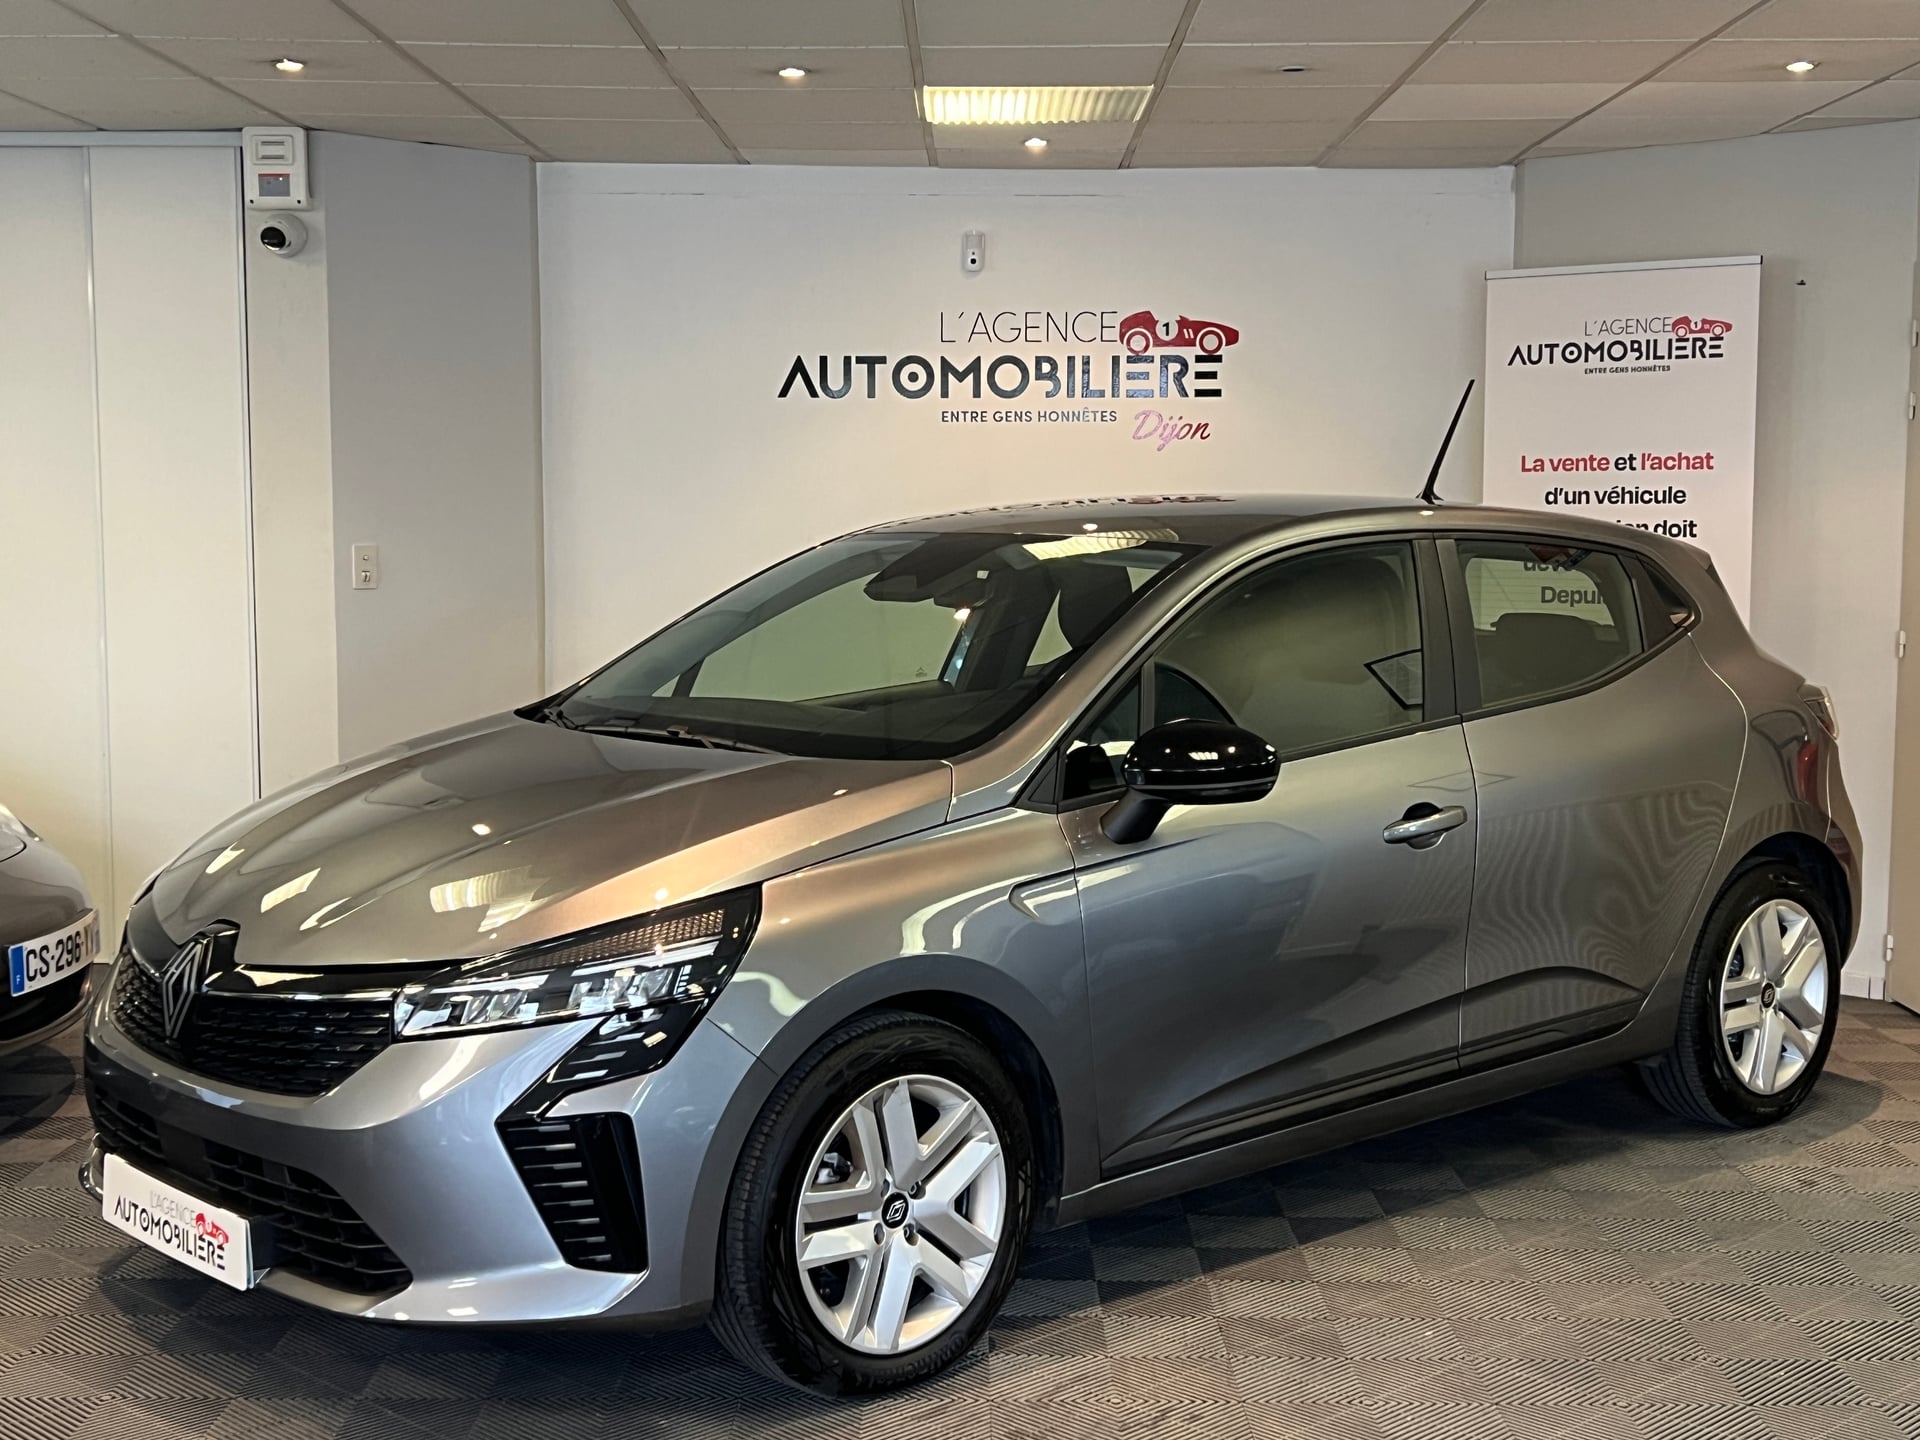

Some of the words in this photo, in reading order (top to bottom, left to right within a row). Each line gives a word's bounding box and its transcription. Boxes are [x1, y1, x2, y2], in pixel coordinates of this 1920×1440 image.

[1584, 367, 1607, 375] ENTRE
[1609, 366, 1629, 374] GENS
[941, 409, 988, 423] ENTRE
[992, 409, 1033, 423] GENS
[1037, 406, 1118, 423] HONNÊTES
[1132, 409, 1211, 452] Dijon
[1521, 455, 1545, 473] La
[1549, 454, 1610, 472] vente
[1614, 453, 1637, 471] et
[1641, 452, 1715, 471] l'achat
[1544, 487, 1590, 505] d'un
[1594, 485, 1687, 505] véhicule
[1654, 520, 1698, 538] doit
